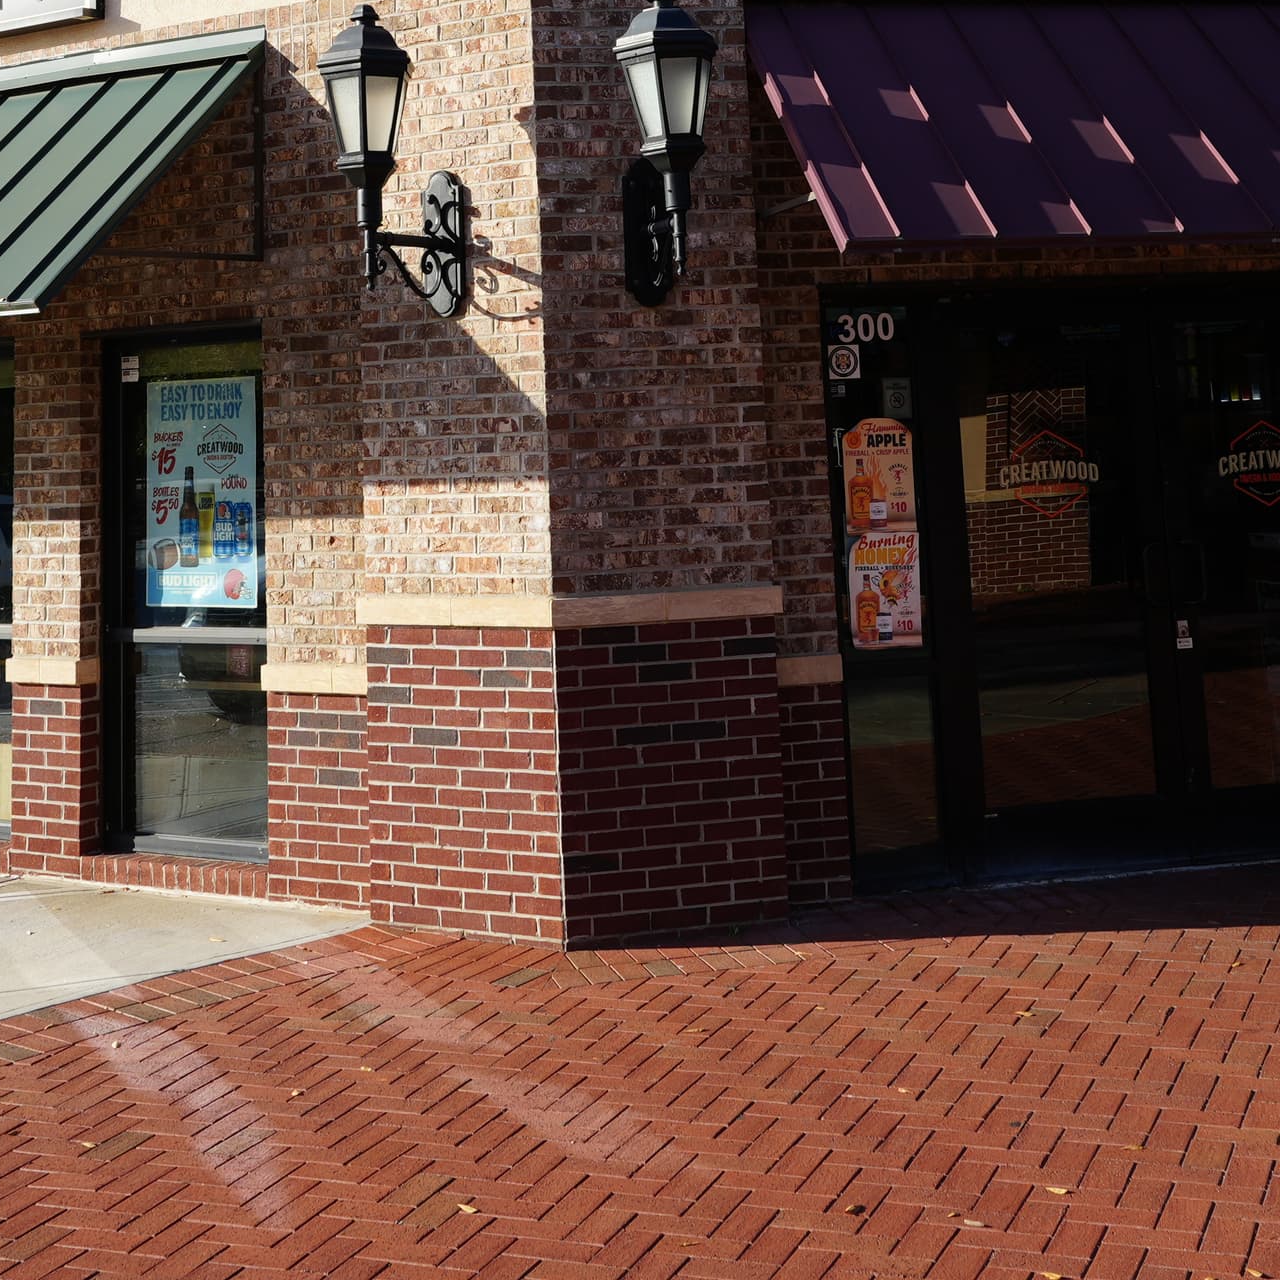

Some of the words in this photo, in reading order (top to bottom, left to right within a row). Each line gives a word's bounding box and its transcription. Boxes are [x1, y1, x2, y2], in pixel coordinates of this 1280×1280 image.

[837, 312, 895, 343] 300
[160, 386, 189, 403] EASY
[190, 384, 206, 402] TO
[206, 382, 243, 401] DRINK
[160, 404, 189, 422] EASY
[190, 402, 206, 421] TO
[206, 400, 242, 420] ENJOY
[196, 440, 244, 457] CREATWOOD
[866, 434, 907, 448] APPLE
[151, 447, 177, 476] $15
[1000, 460, 1100, 487] CREATWOOD
[221, 476, 248, 489] POUND
[152, 486, 180, 498] BOTTLES
[891, 501, 908, 513] $10
[215, 522, 233, 532] BUD
[858, 534, 915, 550] Burning
[854, 548, 907, 566] HONEY
[897, 619, 914, 632] $10
